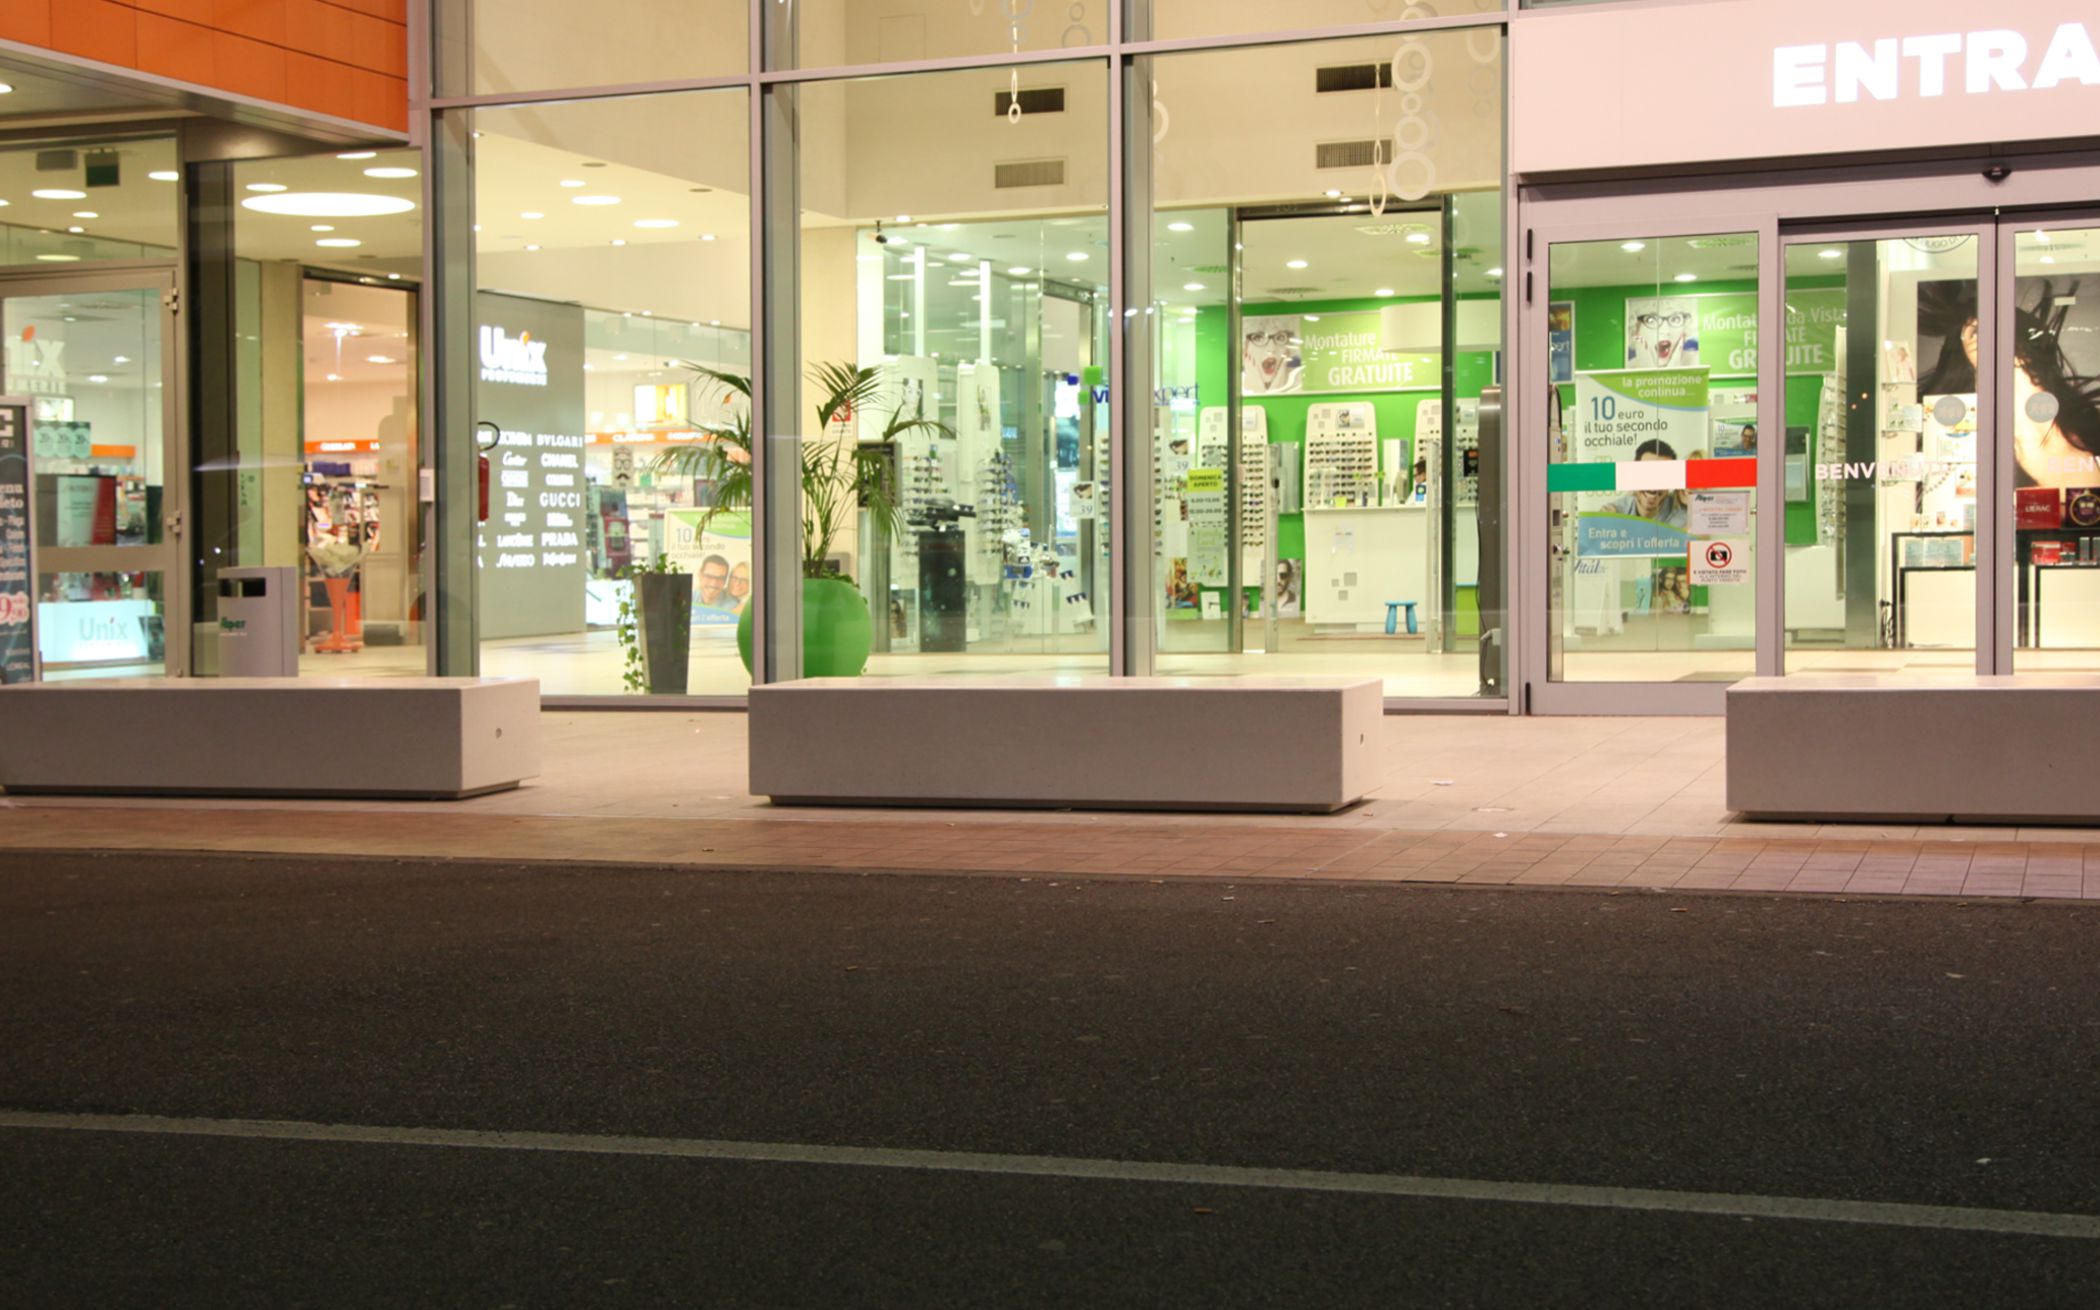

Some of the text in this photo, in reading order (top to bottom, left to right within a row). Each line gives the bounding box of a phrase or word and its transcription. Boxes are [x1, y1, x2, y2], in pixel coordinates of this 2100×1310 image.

[1773, 22, 2100, 108] ENTRA
[1811, 306, 1847, 323] Vista
[480, 325, 547, 370] Unix
[1304, 332, 1377, 350] Montature
[1728, 343, 1824, 370] GRUITE
[1328, 361, 1414, 386] GRATUITE
[1622, 375, 1702, 388] la promozione
[1591, 396, 1644, 420] 10 euro
[1584, 418, 1668, 433] il tuo secondo
[1584, 434, 1637, 447] occhiale!
[540, 492, 580, 508] GUCCI
[541, 532, 579, 547] PRADA
[676, 527, 693, 543] 10
[1589, 528, 1627, 538] Entra e
[1601, 537, 1680, 551] scopri l'offerta
[79, 616, 127, 640] Unix
